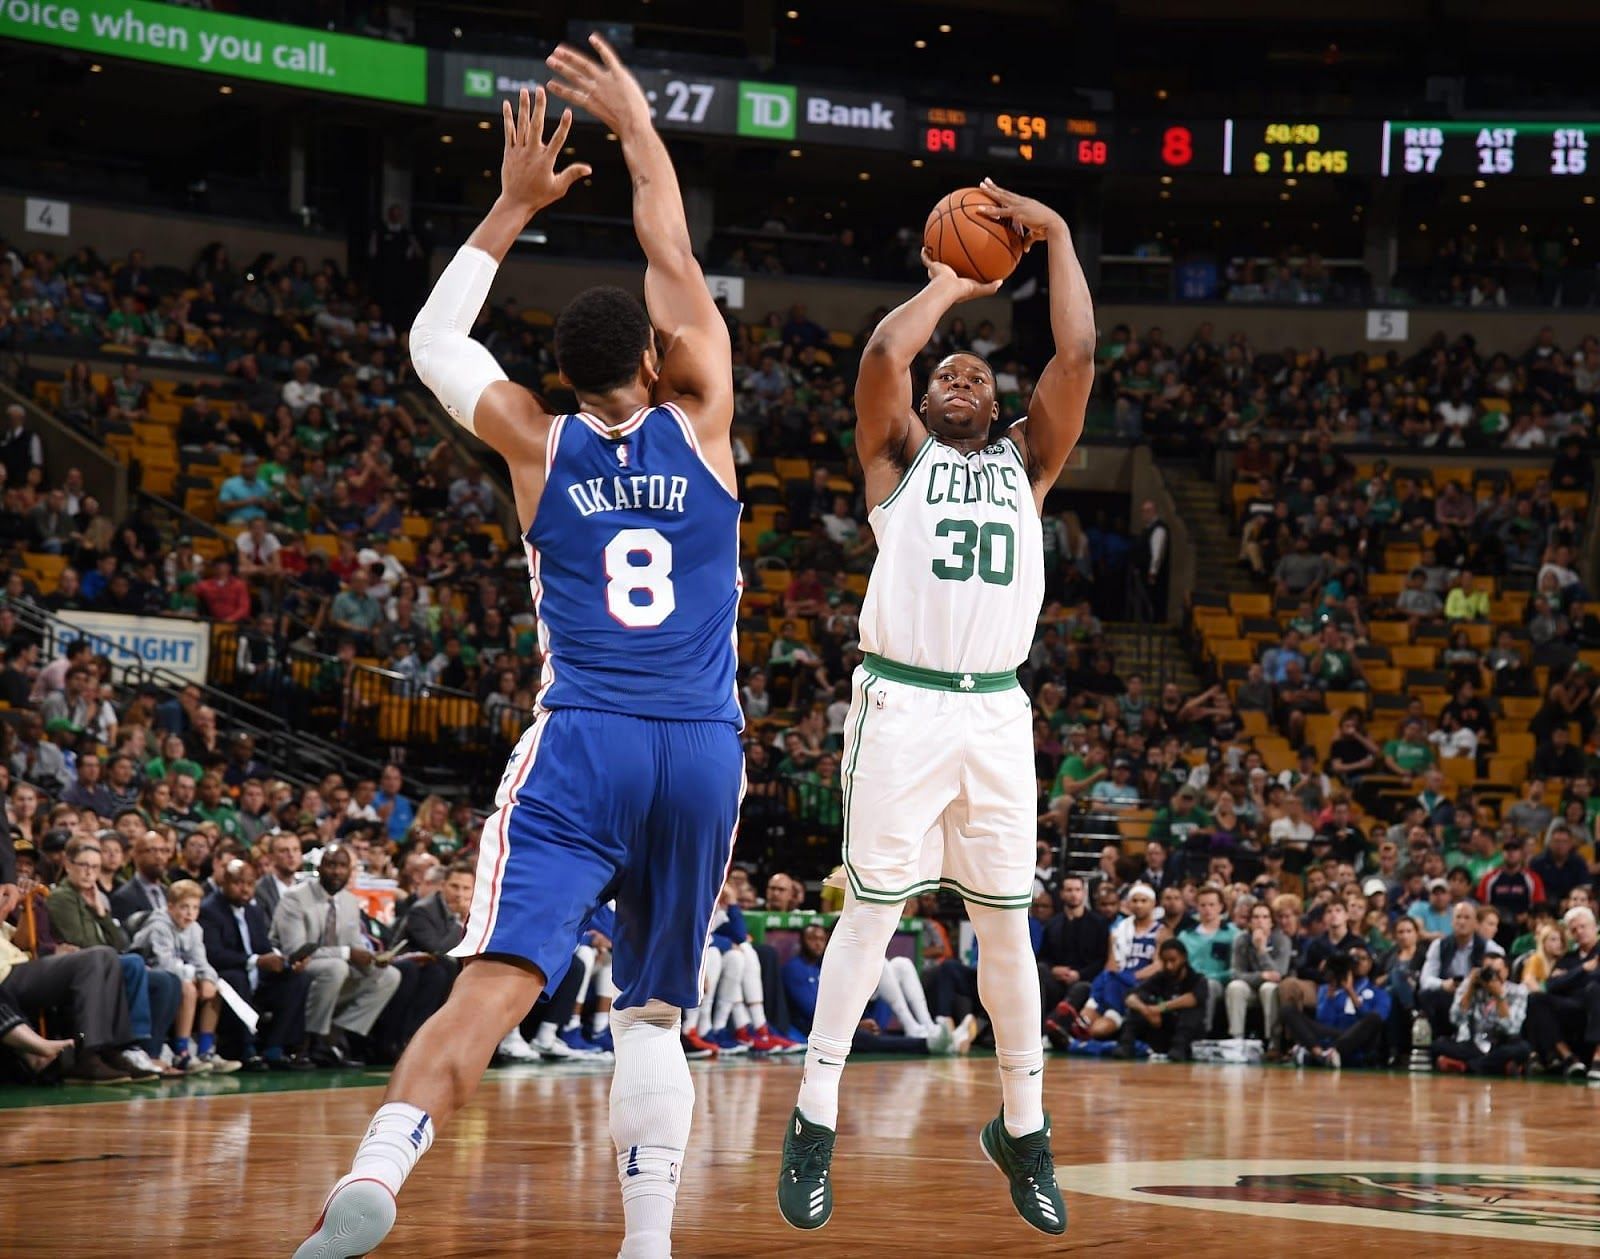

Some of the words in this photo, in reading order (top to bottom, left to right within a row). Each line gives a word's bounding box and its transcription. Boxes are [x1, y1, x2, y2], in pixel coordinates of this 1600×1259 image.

[91, 9, 188, 51] when
[198, 31, 262, 63] you
[272, 42, 336, 77] call.
[745, 92, 792, 128] TD
[806, 97, 894, 130] Bank
[926, 128, 956, 151] 89
[1161, 126, 1193, 166] 8
[1404, 128, 1444, 147] REB
[1475, 128, 1518, 148] AST
[1552, 129, 1589, 148] STL
[1404, 147, 1442, 173] 57
[1478, 148, 1514, 174] 15
[1551, 148, 1587, 174] 15
[39, 204, 53, 229] 4
[1379, 312, 1393, 337] 5
[567, 474, 689, 517] OKAFOR
[931, 518, 1015, 586] 30
[603, 528, 676, 630] 8
[118, 634, 194, 663] LIGHT
